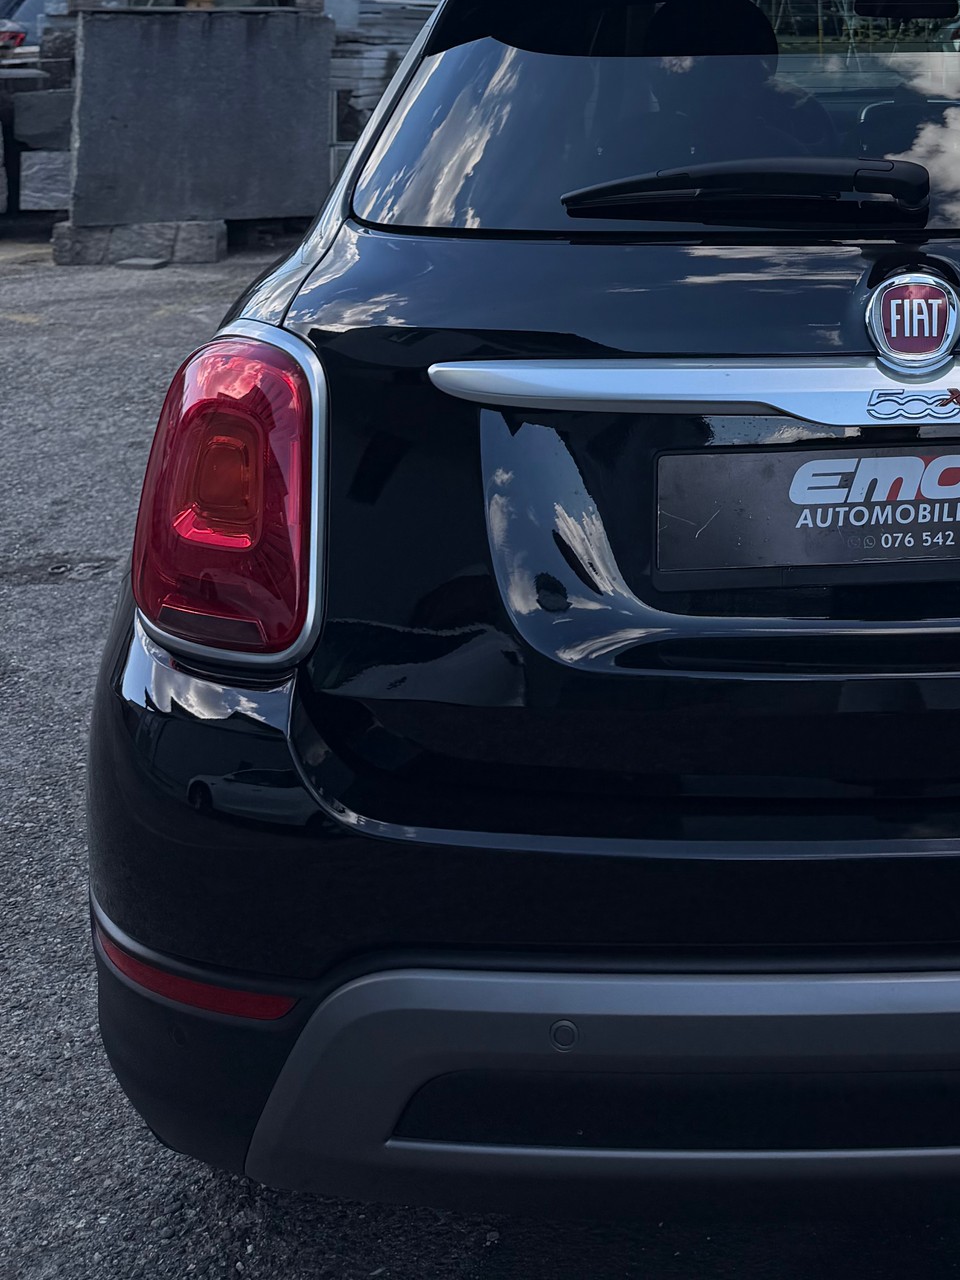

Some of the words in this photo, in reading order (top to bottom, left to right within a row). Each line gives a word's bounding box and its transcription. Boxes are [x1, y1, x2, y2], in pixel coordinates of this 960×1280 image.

[890, 299, 942, 338] FIAT
[881, 532, 915, 548] 076
[922, 530, 955, 547] 542
